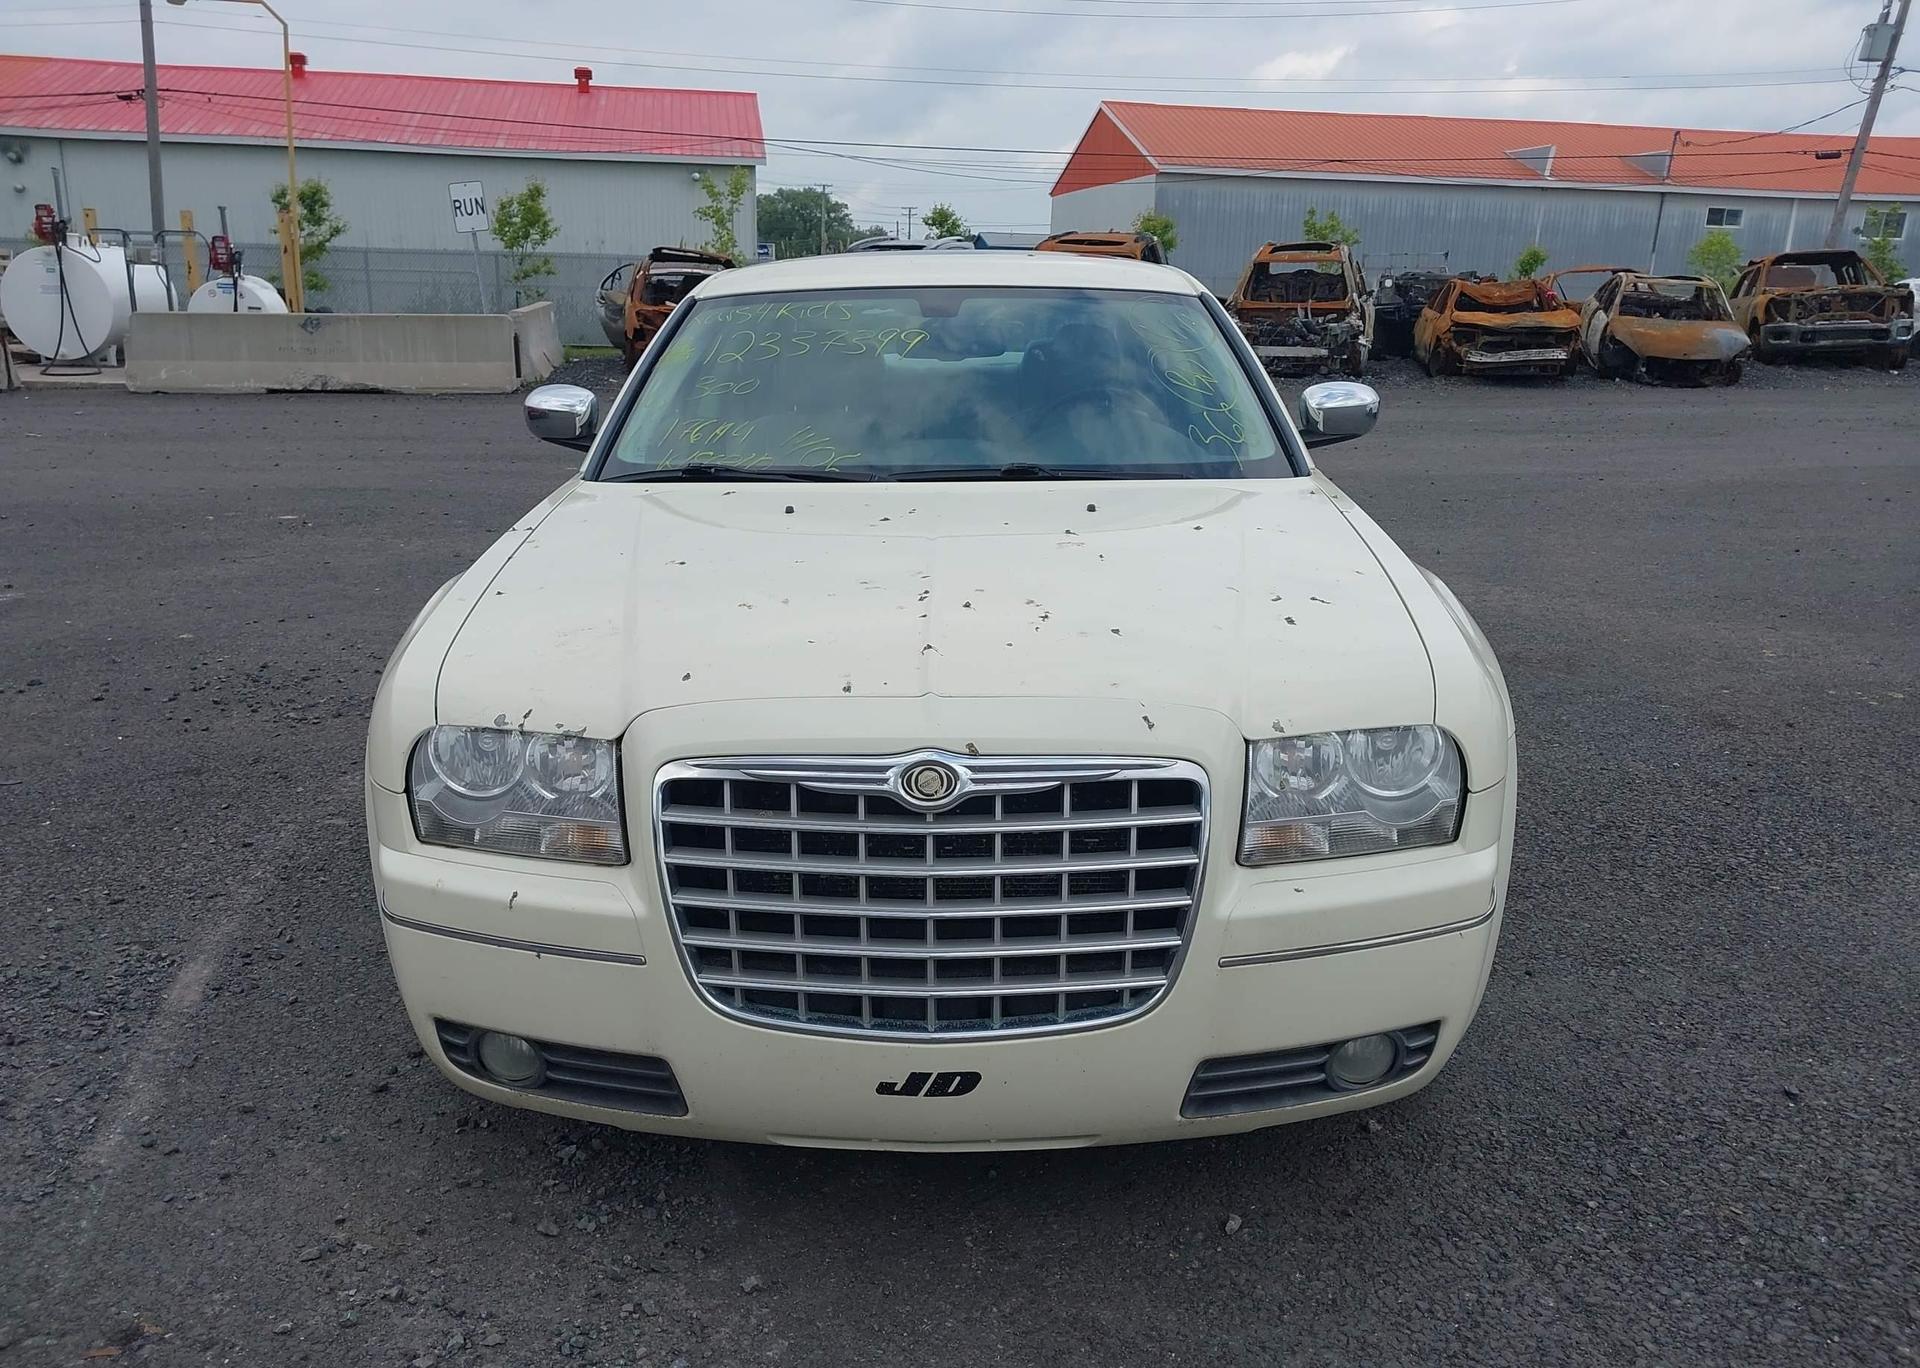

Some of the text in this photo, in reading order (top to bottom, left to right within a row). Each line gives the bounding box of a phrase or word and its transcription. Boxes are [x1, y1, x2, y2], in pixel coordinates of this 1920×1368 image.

[453, 197, 485, 217] RUN
[689, 375, 760, 400] 300
[876, 1072, 982, 1098] JD
